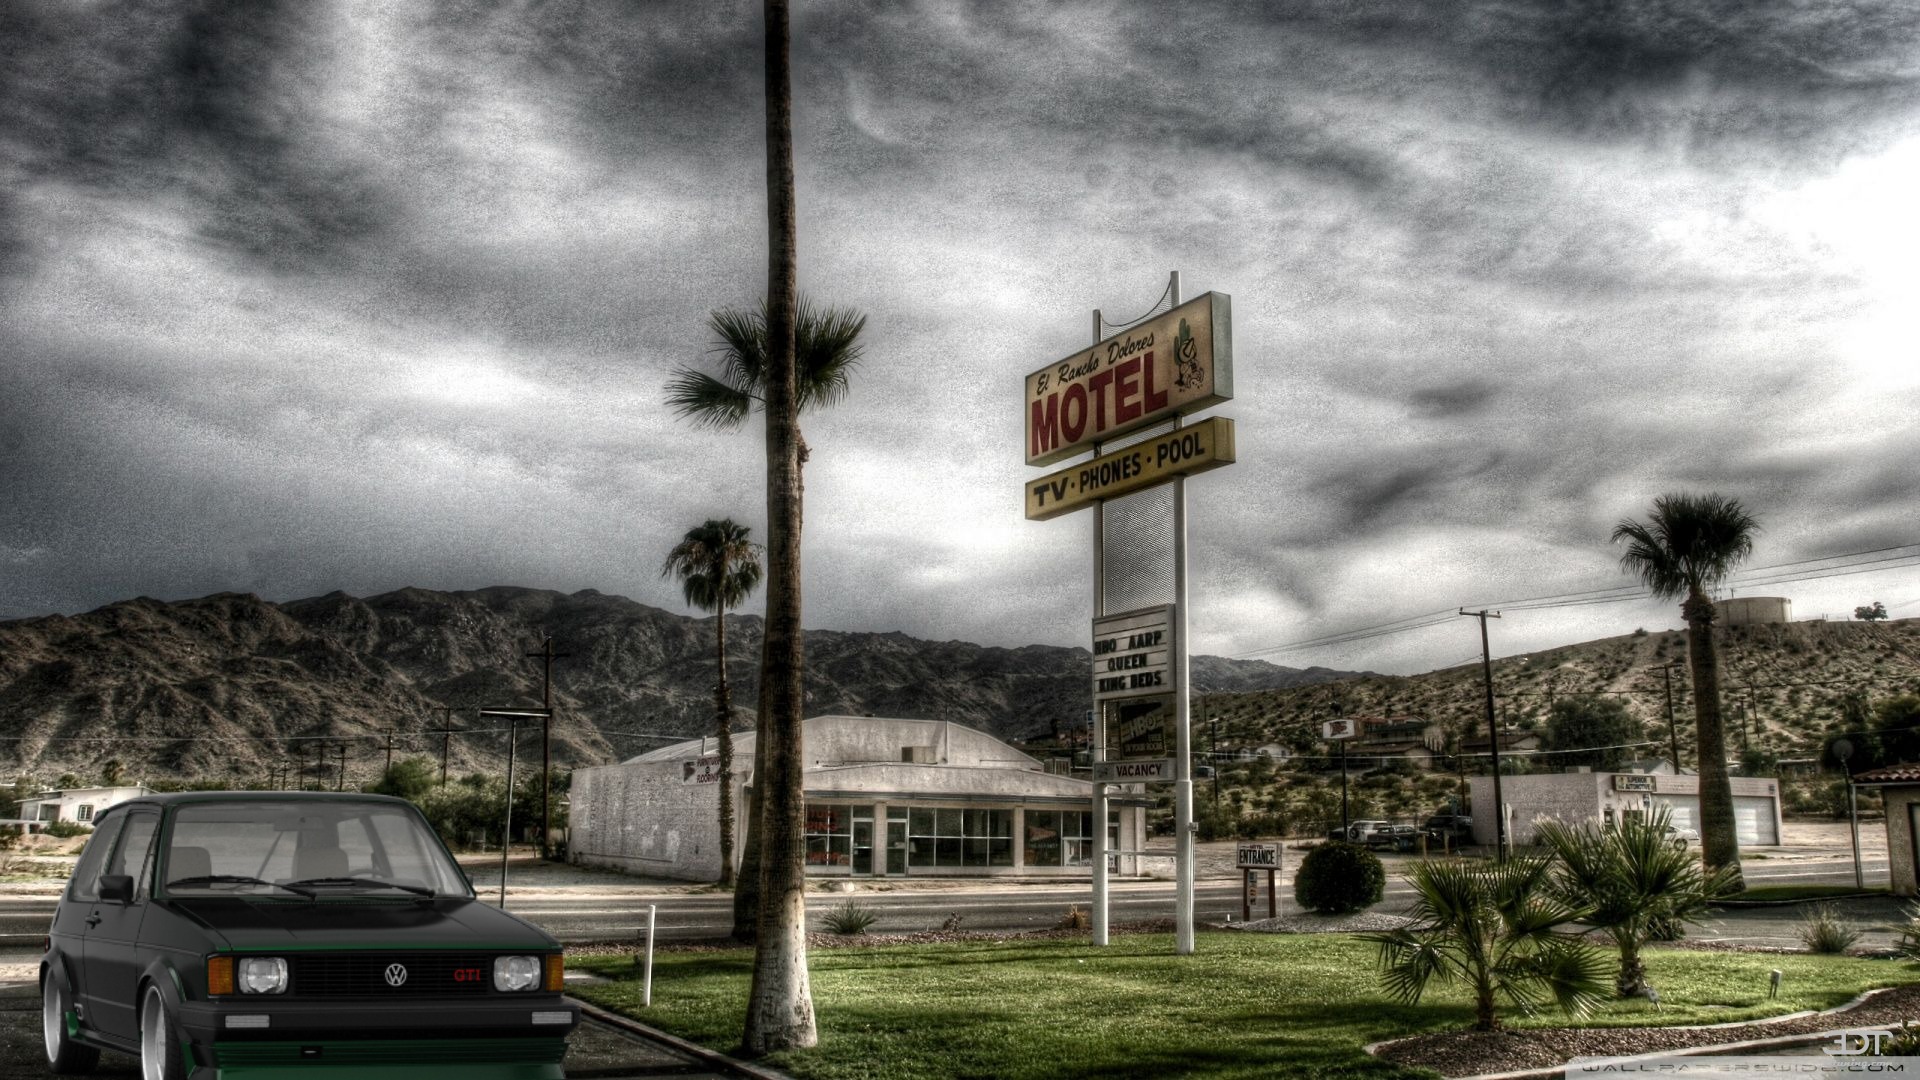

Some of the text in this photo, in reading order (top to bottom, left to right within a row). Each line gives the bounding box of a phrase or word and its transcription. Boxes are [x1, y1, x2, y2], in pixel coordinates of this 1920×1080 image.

[1036, 332, 1155, 396] El Rancho Dolores
[1031, 351, 1168, 457] MOTEL
[1033, 431, 1206, 507] TV PHONES POOL
[1128, 630, 1162, 650] AARP
[1107, 653, 1148, 672] QUEEN
[1098, 670, 1162, 693] KING BEDS
[1129, 713, 1158, 738] HBO
[1116, 763, 1162, 777] VACANCY
[1240, 849, 1275, 865] ENTRANCE
[453, 968, 481, 982] GTI
